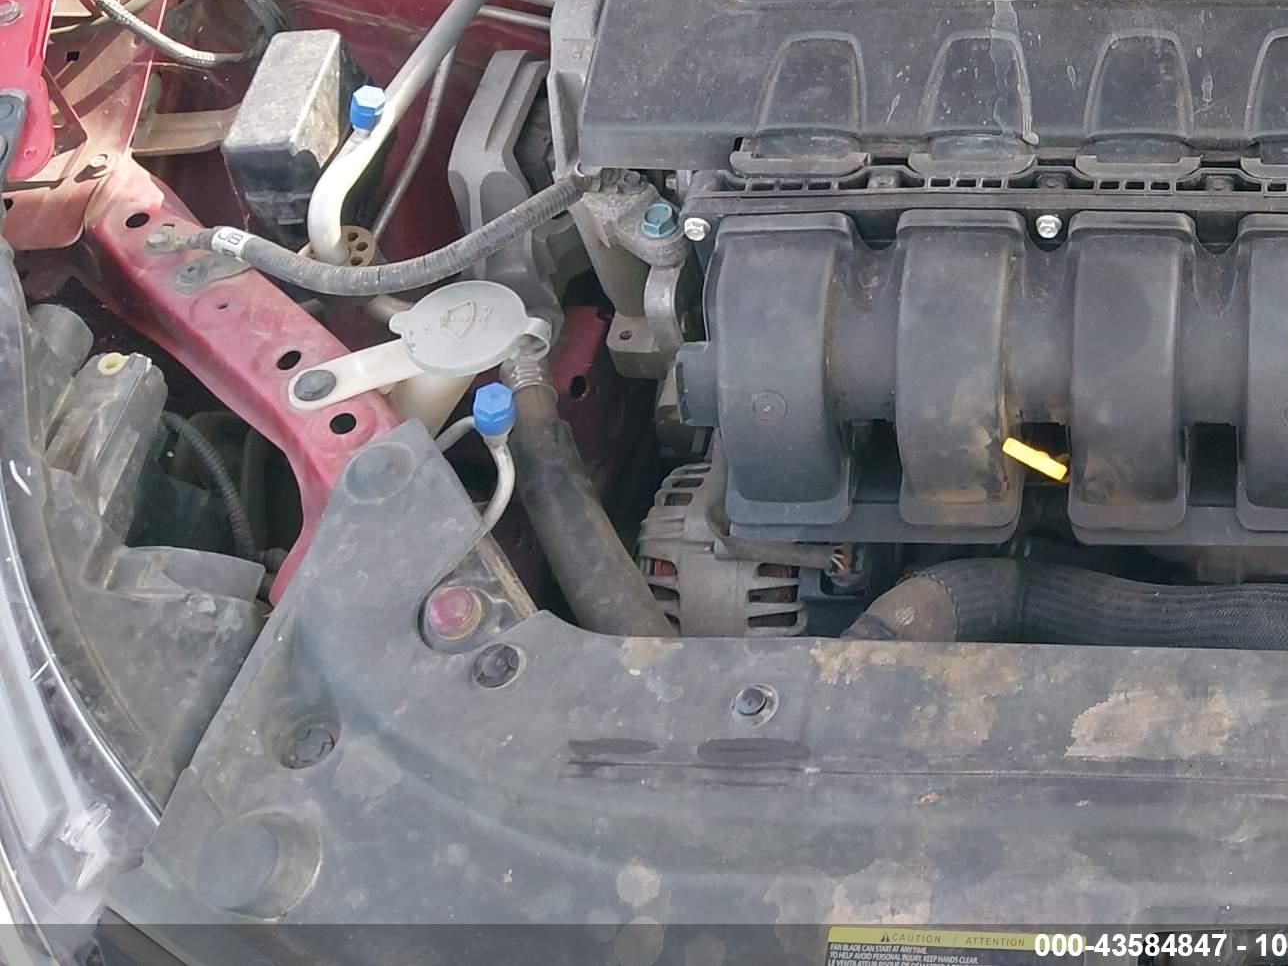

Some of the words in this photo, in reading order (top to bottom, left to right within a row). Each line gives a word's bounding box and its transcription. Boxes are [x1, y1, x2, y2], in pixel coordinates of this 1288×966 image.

[892, 933, 941, 944] CAUTION
[965, 936, 1025, 947] ATTENTION
[830, 943, 842, 951] FAN
[843, 944, 861, 952] BLADE
[875, 945, 892, 953] START
[873, 953, 901, 961] PERSONAL
[923, 954, 938, 962] KEEP
[938, 955, 959, 963] HANDS
